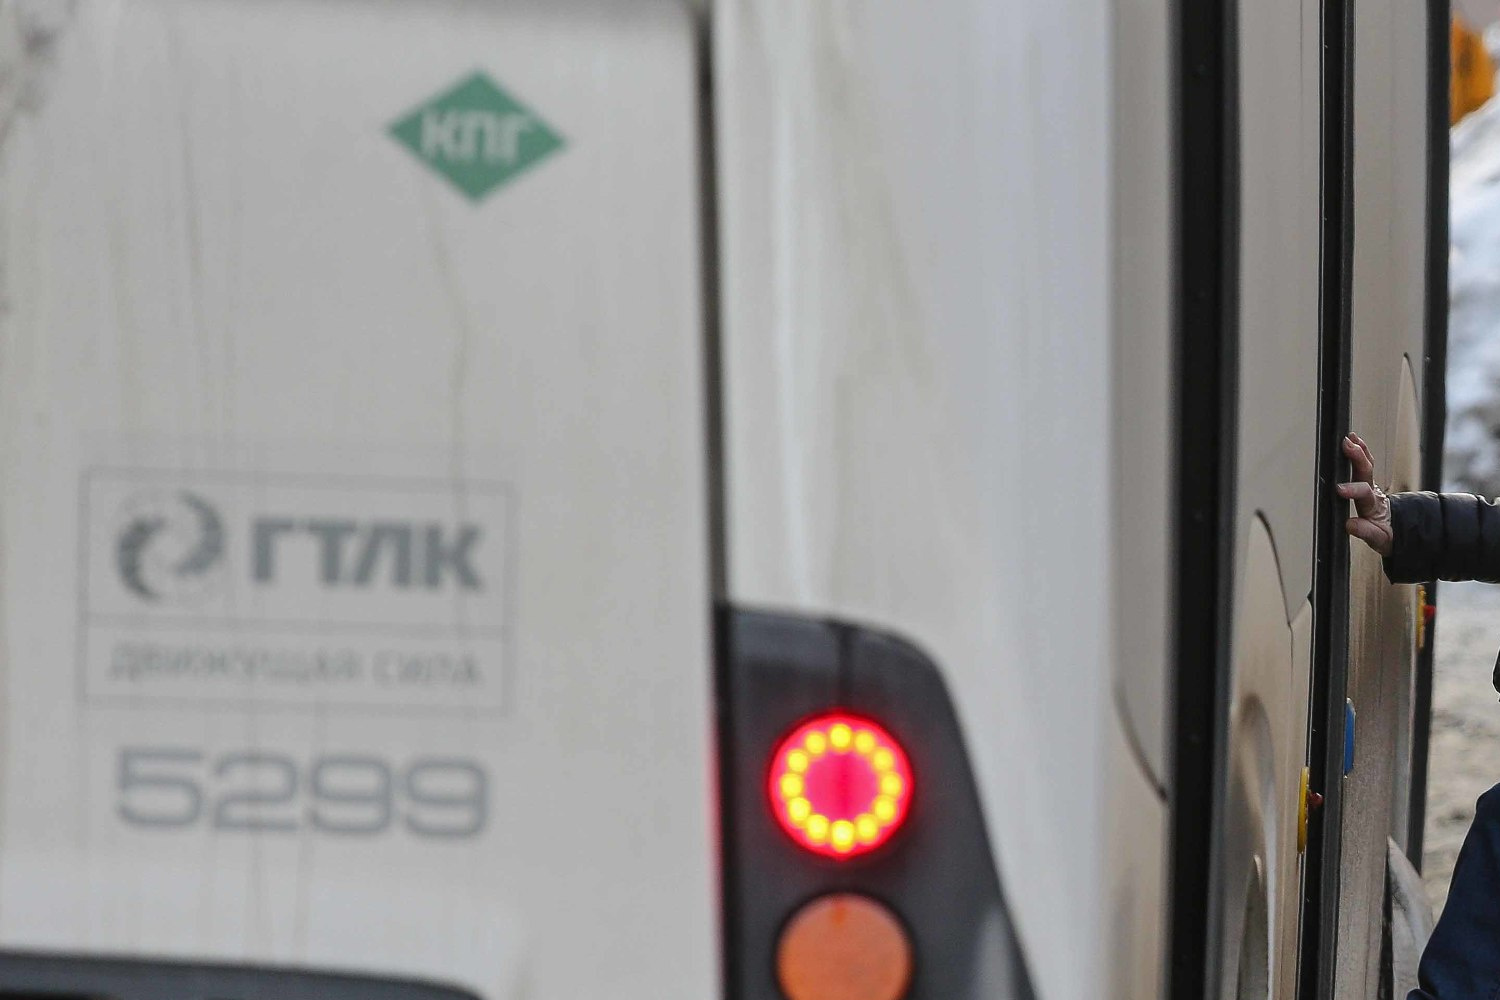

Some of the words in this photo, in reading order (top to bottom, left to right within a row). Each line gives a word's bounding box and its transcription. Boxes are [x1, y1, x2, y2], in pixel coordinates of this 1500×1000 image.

[420, 108, 528, 166] КПГ
[250, 515, 485, 592] ГТЛК
[371, 650, 483, 689] СИЛА
[114, 745, 490, 838] 5299
